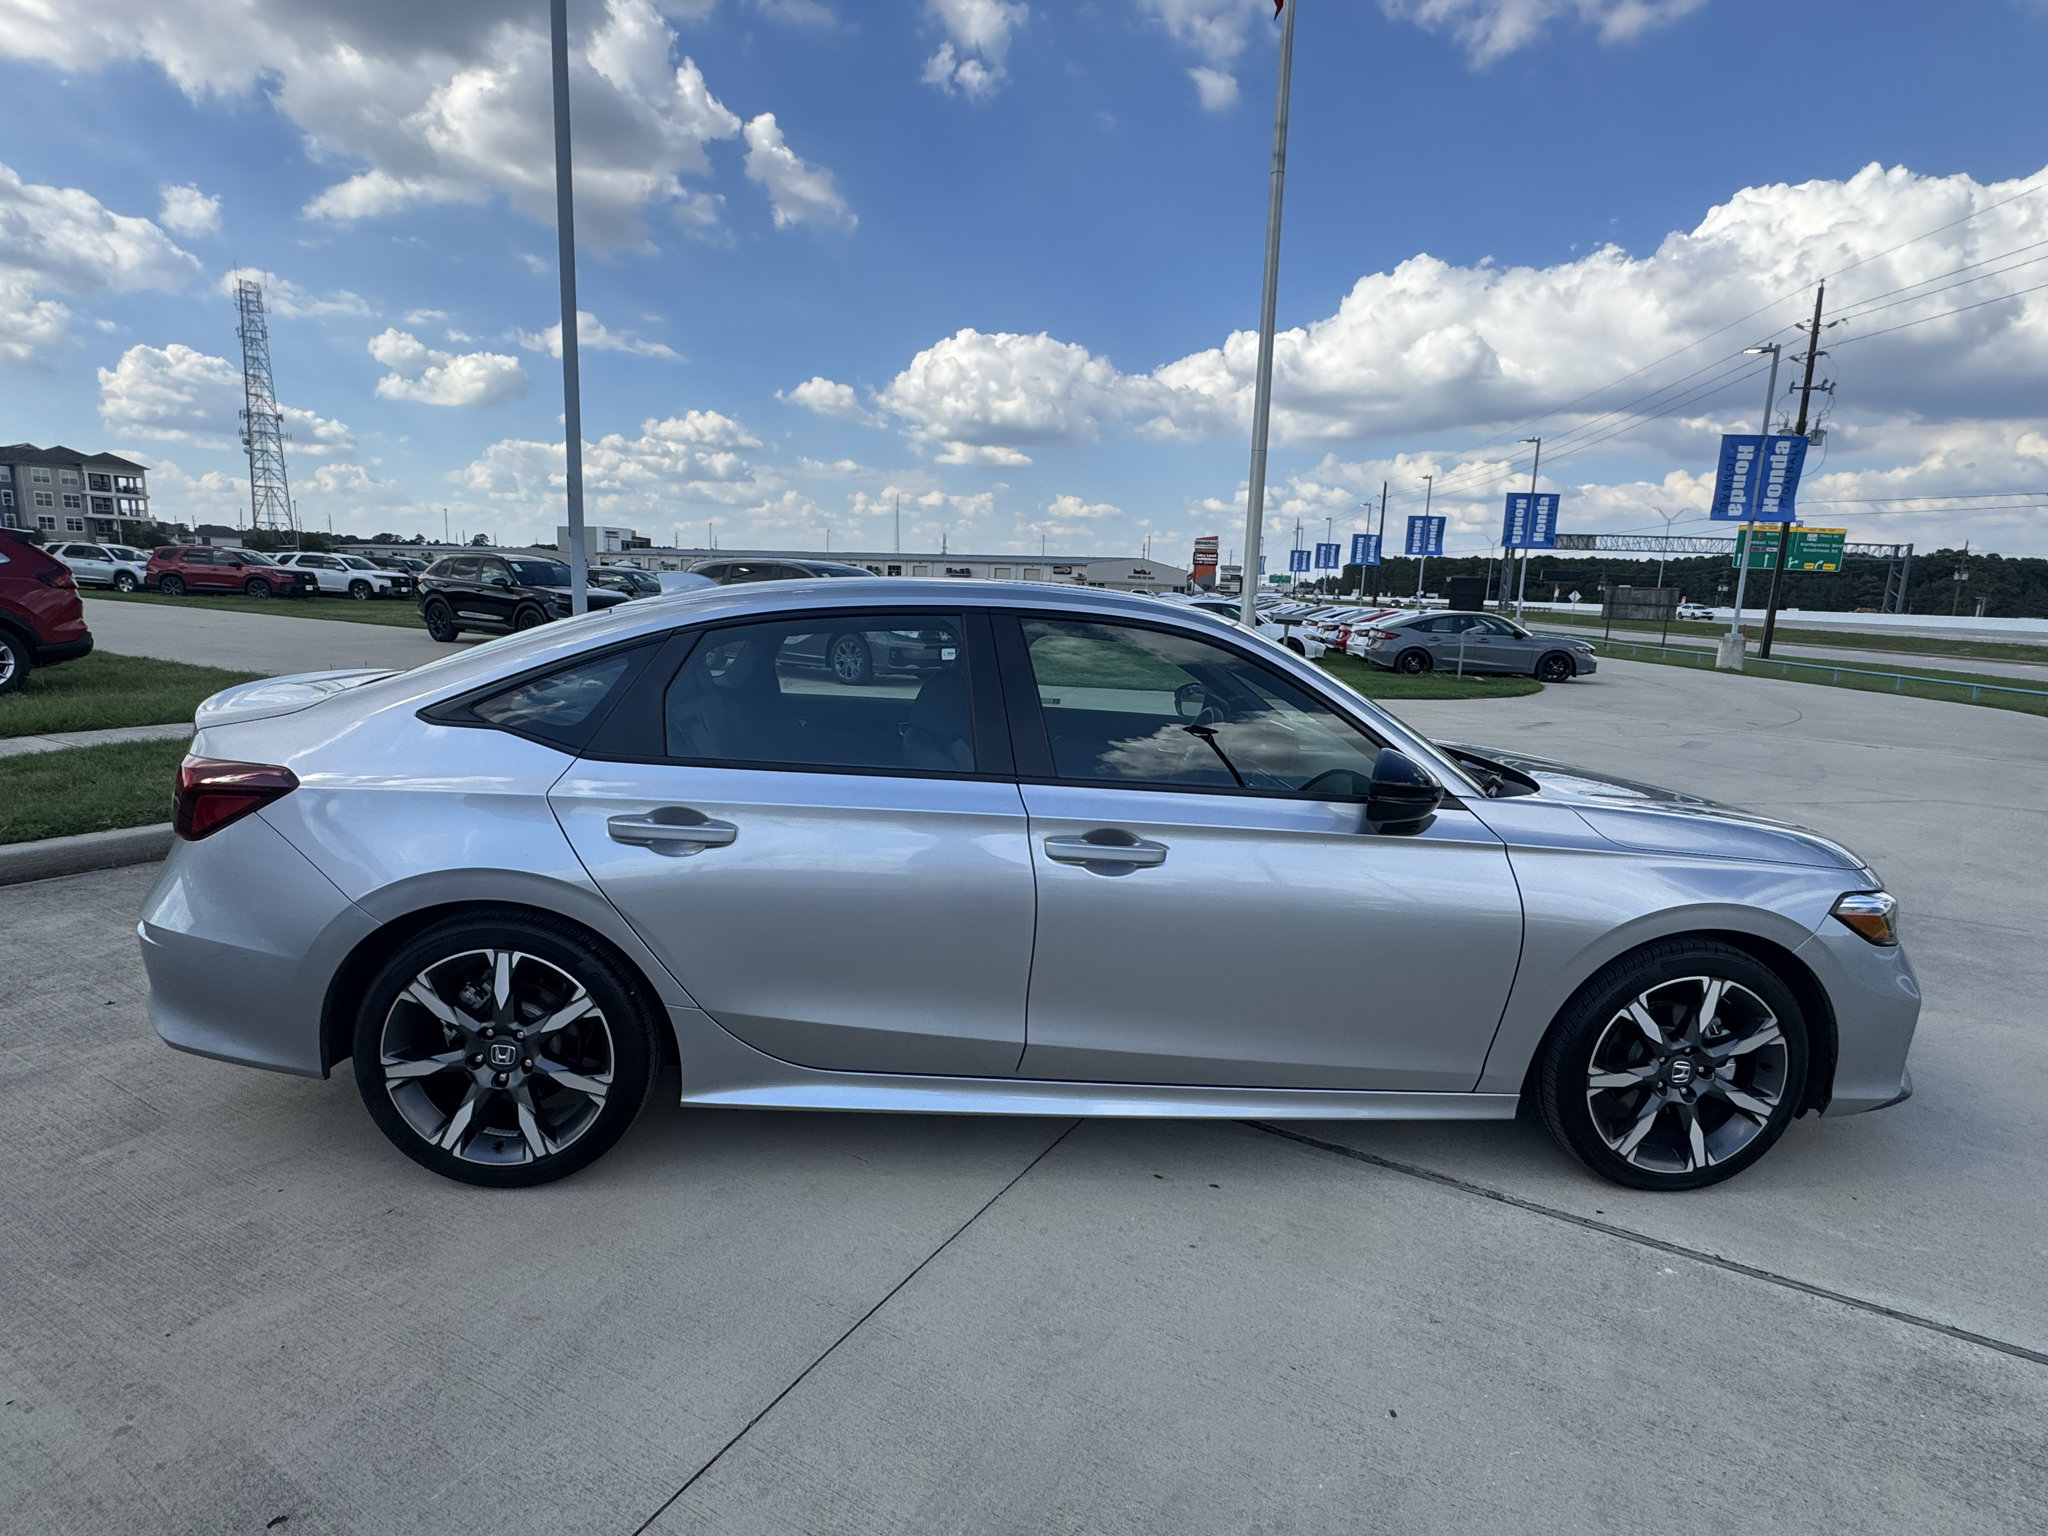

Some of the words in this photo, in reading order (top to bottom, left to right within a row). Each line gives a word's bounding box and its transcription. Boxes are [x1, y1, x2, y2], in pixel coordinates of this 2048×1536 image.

[1719, 456, 1736, 513] TOMBALL
[1728, 445, 1755, 516] Honda
[1762, 441, 1791, 512] Honda
[1781, 442, 1800, 507] TOMBALL
[1412, 520, 1423, 553] Honda
[1427, 518, 1439, 552] Honda
[1511, 499, 1528, 543] Honda
[1533, 497, 1550, 542] Honda
[1355, 537, 1365, 563] Honda
[1368, 536, 1377, 562] Honda
